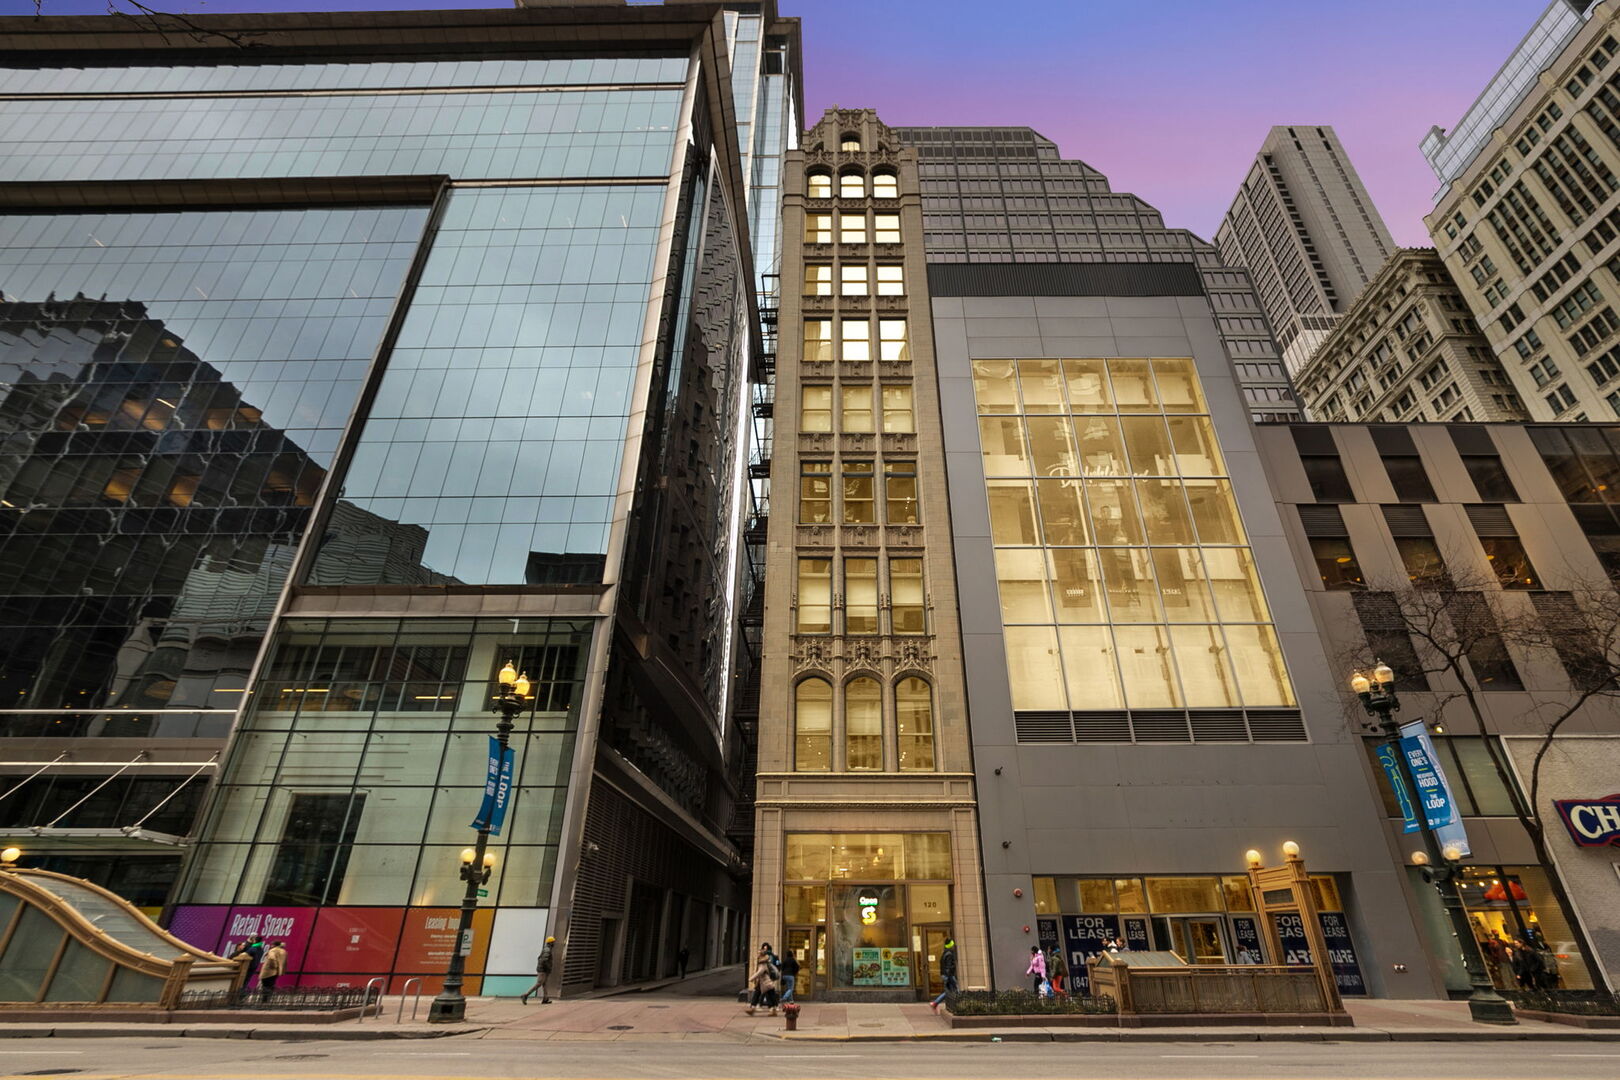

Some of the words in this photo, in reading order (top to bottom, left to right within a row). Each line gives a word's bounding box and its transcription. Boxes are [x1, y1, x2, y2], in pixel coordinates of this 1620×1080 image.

[1407, 749, 1423, 759] EVERY
[1418, 776, 1439, 788] HOOD
[496, 774, 510, 808] LOOP
[1426, 798, 1446, 809] LOOP
[230, 914, 262, 936] Retail
[261, 914, 295, 938] Space
[1041, 921, 1053, 931] FOR
[1076, 917, 1104, 928] FOR
[1128, 921, 1141, 931] FOR
[1238, 920, 1250, 930] FOR
[1323, 915, 1340, 926] FOR
[1040, 931, 1056, 940] LEASE
[1069, 928, 1114, 939] LEASE
[1127, 930, 1146, 940] LEASE
[1237, 930, 1256, 939] LEASE
[1279, 927, 1304, 938] EAS
[1323, 926, 1347, 937] LEASE
[1073, 976, 1088, 990] (847
